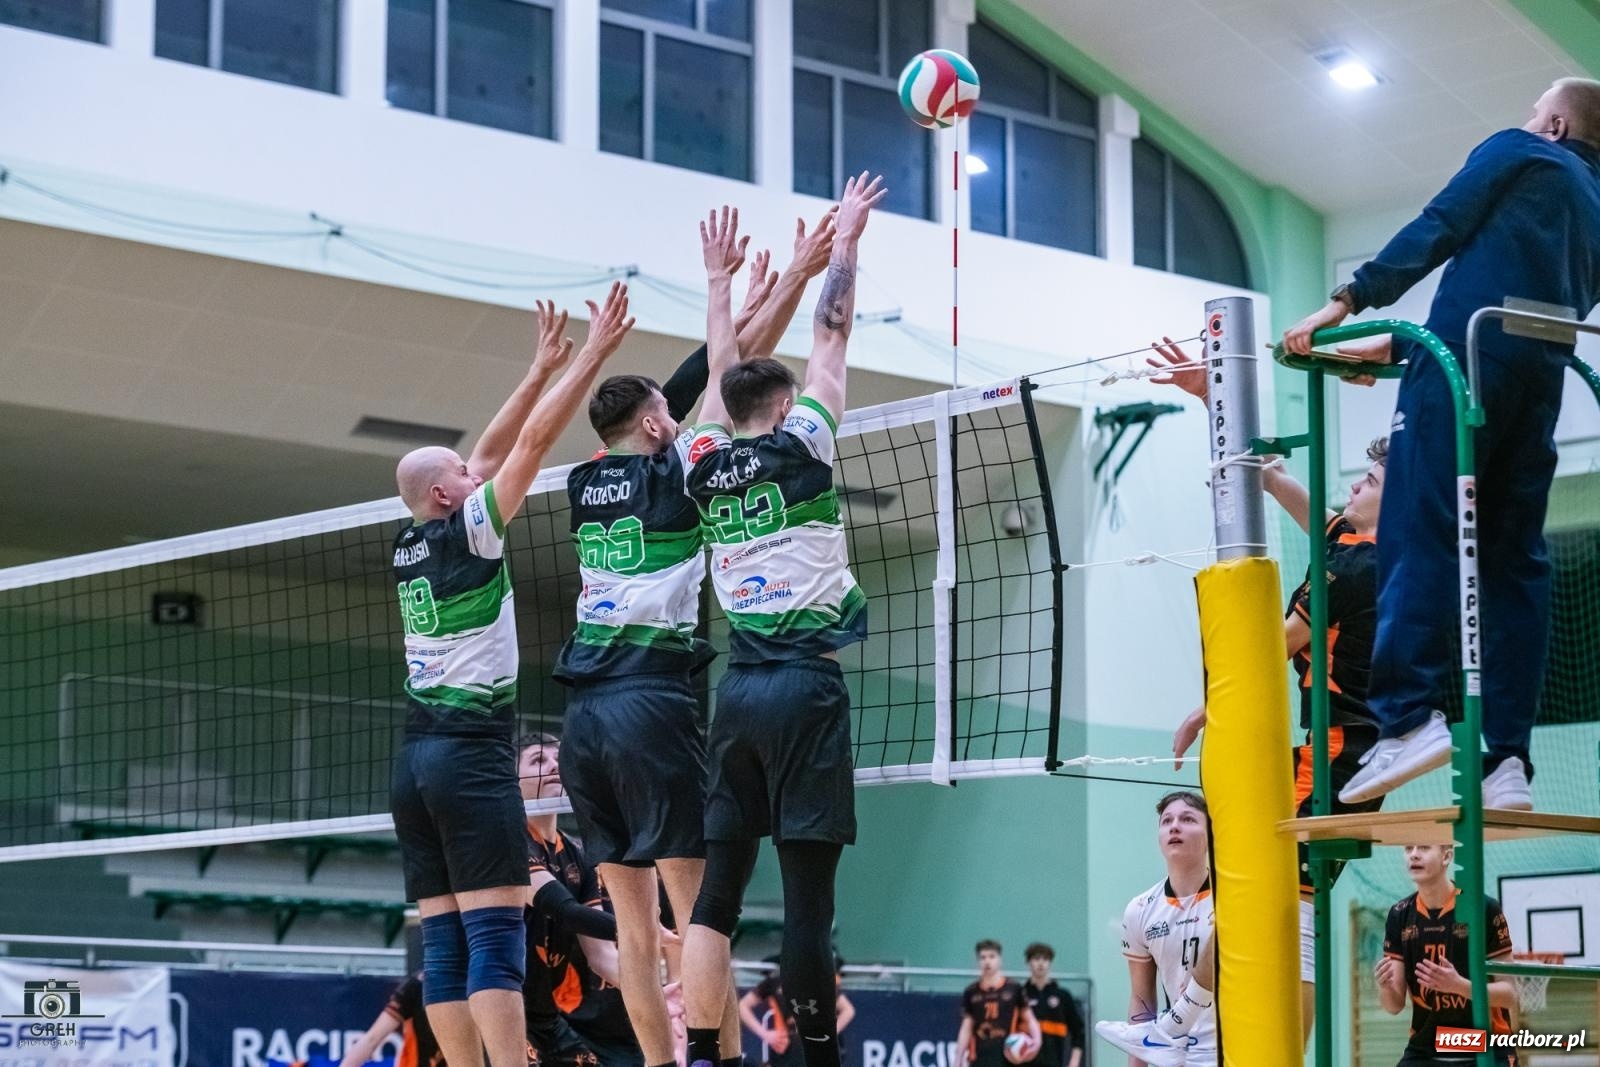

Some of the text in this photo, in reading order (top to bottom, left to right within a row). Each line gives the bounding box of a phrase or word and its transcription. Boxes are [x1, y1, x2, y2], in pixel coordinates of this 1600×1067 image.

[983, 386, 1013, 400] netex
[709, 481, 786, 545] 23
[577, 515, 646, 573] 69
[397, 576, 439, 636] 19
[79, 1026, 158, 1050] FM
